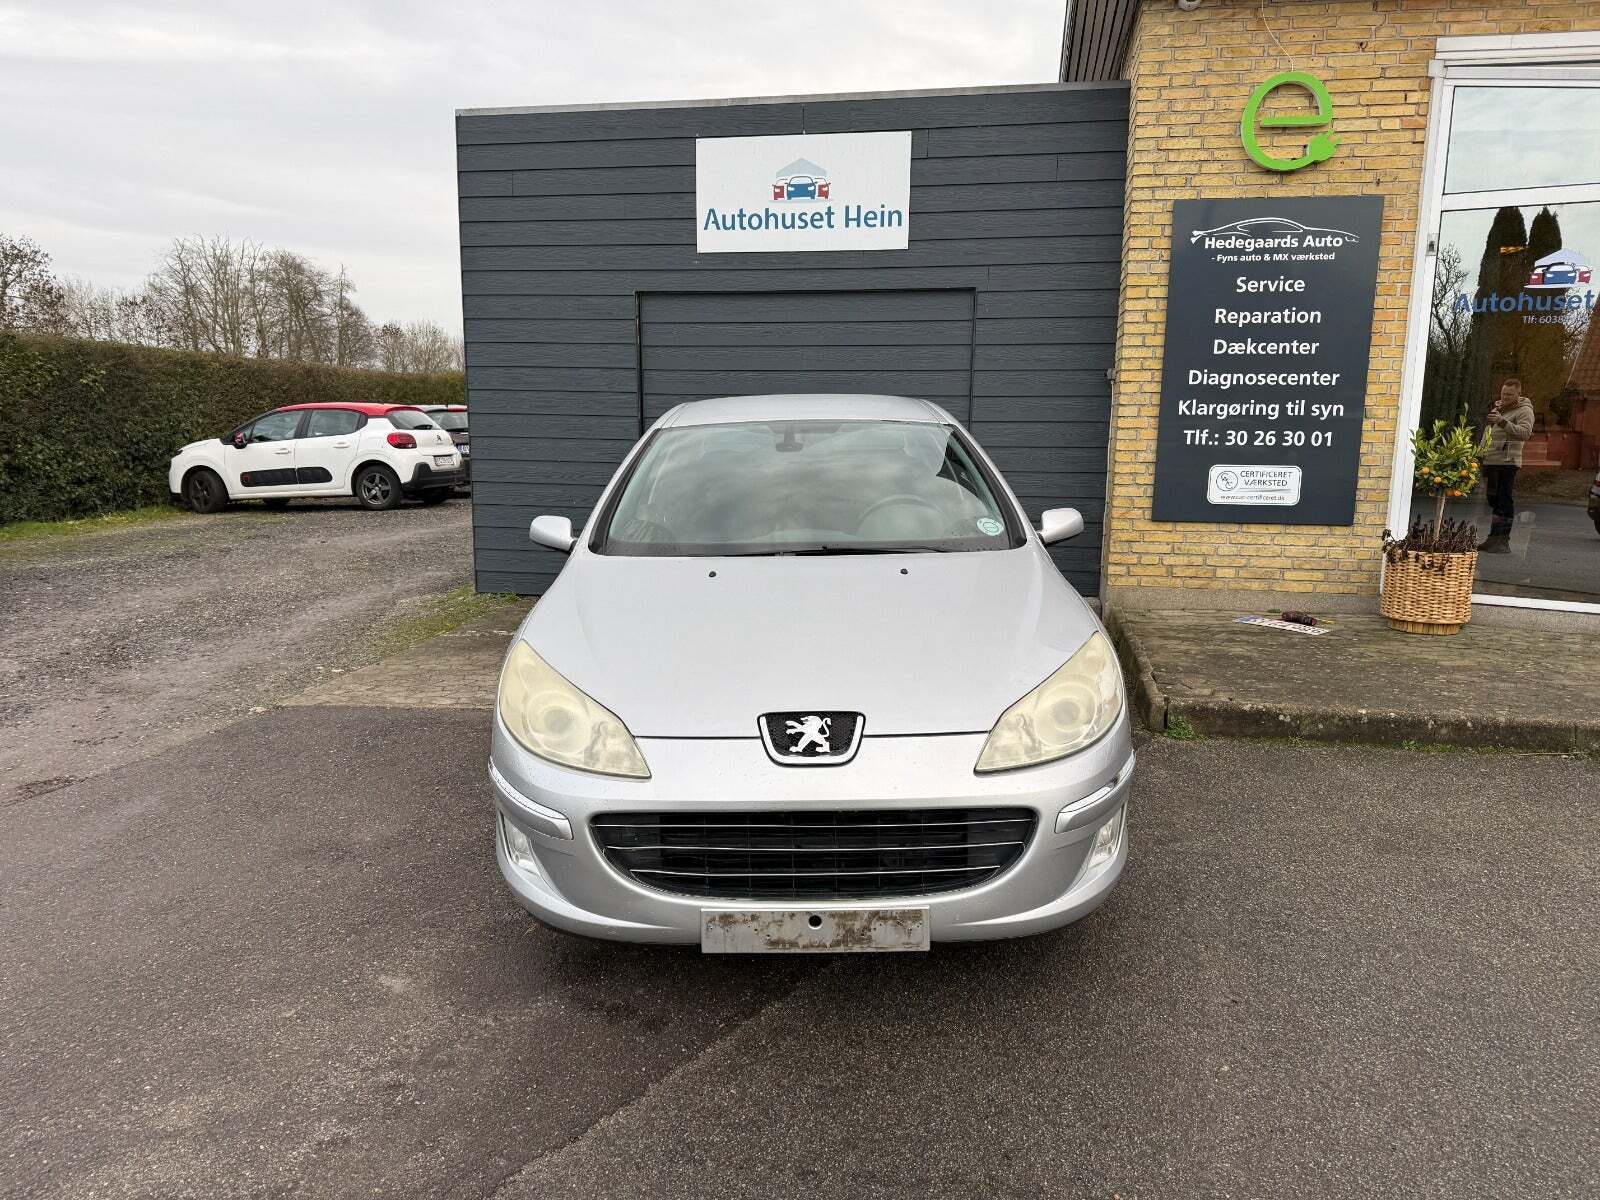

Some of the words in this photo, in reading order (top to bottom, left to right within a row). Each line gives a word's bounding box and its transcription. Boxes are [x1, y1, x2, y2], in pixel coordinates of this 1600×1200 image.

[704, 206, 835, 230] Autohuset
[845, 204, 903, 228] Hein
[1205, 235, 1298, 251] Hedegaards
[1303, 234, 1343, 248] Auto
[1217, 254, 1238, 263] Fyns
[1264, 253, 1271, 261] &
[1273, 253, 1289, 261] MX
[1291, 252, 1335, 261] værksted
[1236, 276, 1305, 293] Service
[1454, 289, 1595, 313] Autohuset
[1214, 307, 1322, 327] Reparation
[1213, 338, 1320, 355] Dækcenter
[1188, 369, 1340, 389] Diagnosecenter
[1178, 399, 1280, 420] Klargøring
[1286, 400, 1305, 416] til
[1311, 403, 1344, 421] syn
[1183, 429, 1219, 446] Tlf.:
[1225, 430, 1248, 446] 30
[1253, 431, 1276, 446] 26
[1282, 431, 1305, 447] 30
[1310, 431, 1333, 447] 01
[1240, 470, 1293, 478] CERTIFICERET
[1244, 479, 1288, 487] VÆRKSTED
